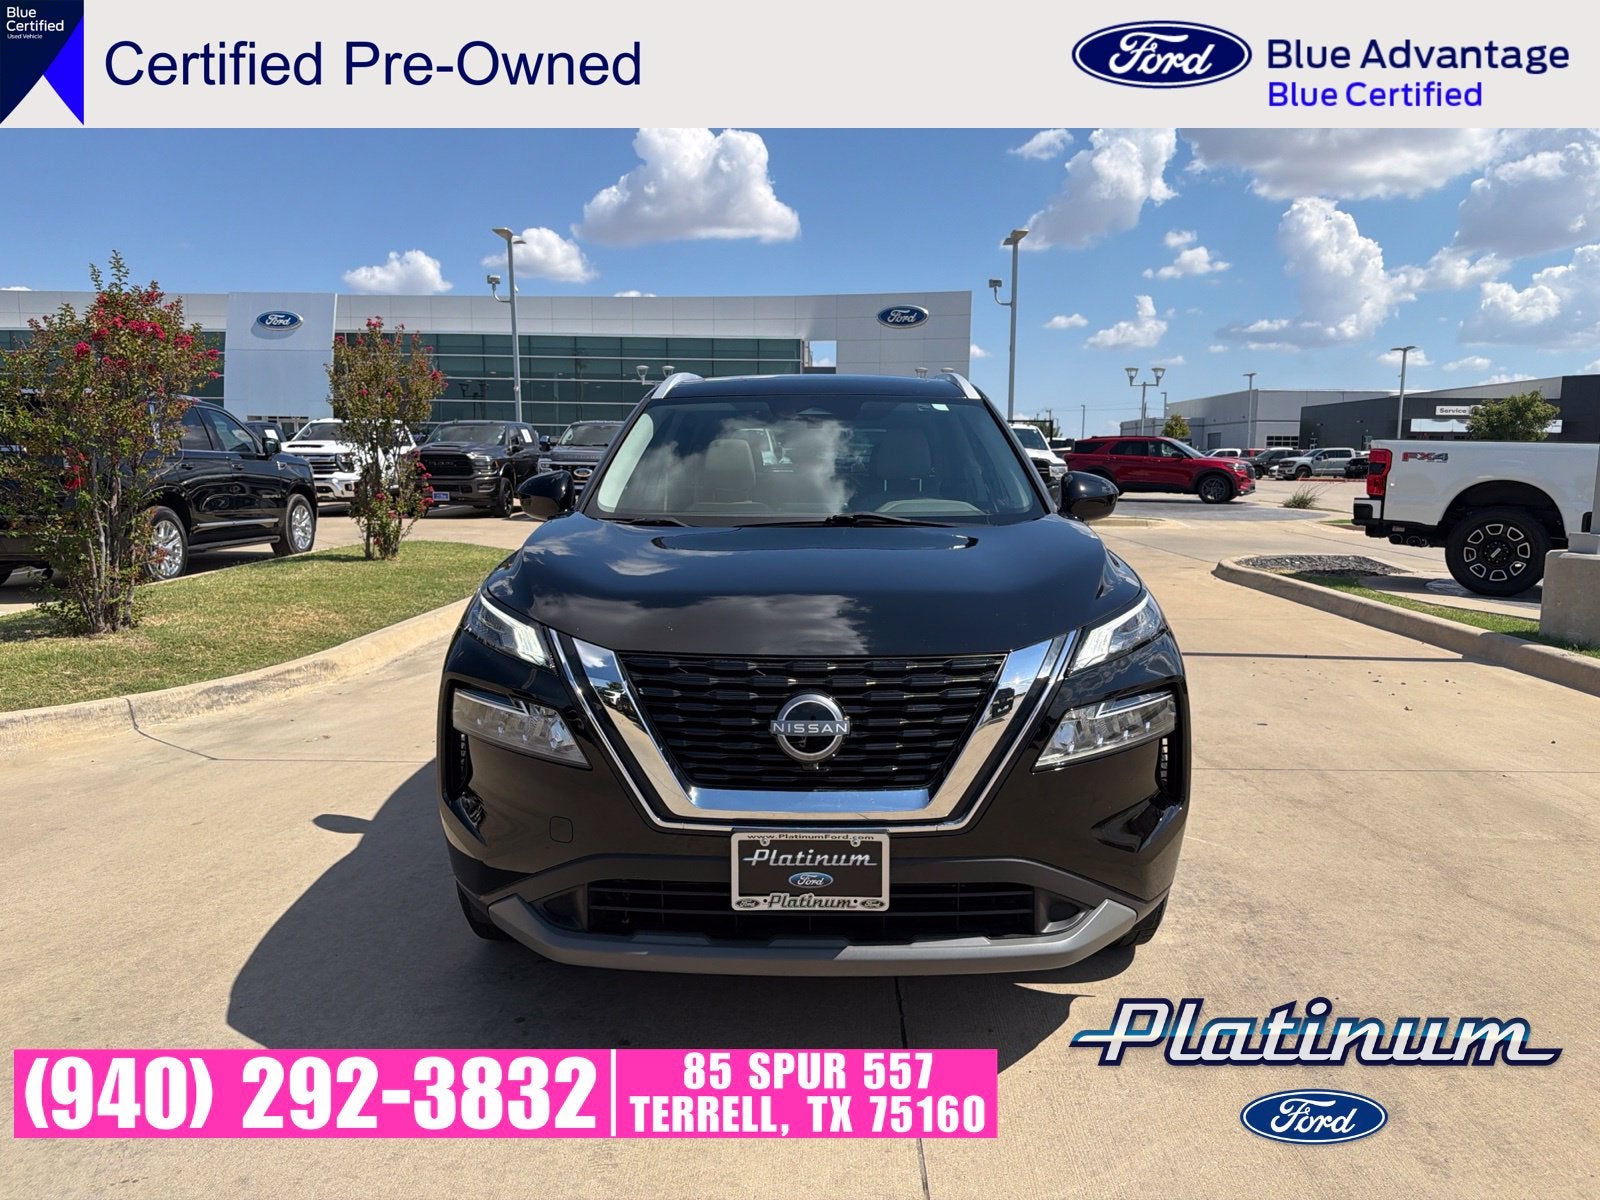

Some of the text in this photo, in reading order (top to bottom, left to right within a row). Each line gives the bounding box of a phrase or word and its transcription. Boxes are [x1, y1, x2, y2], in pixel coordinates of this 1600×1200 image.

[1401, 452, 1449, 462] FX4
[773, 723, 848, 733] NISSAN
[747, 833, 875, 841] www.PlatinumFord.com
[742, 849, 878, 867] Platinum
[767, 894, 859, 909] Platinum
